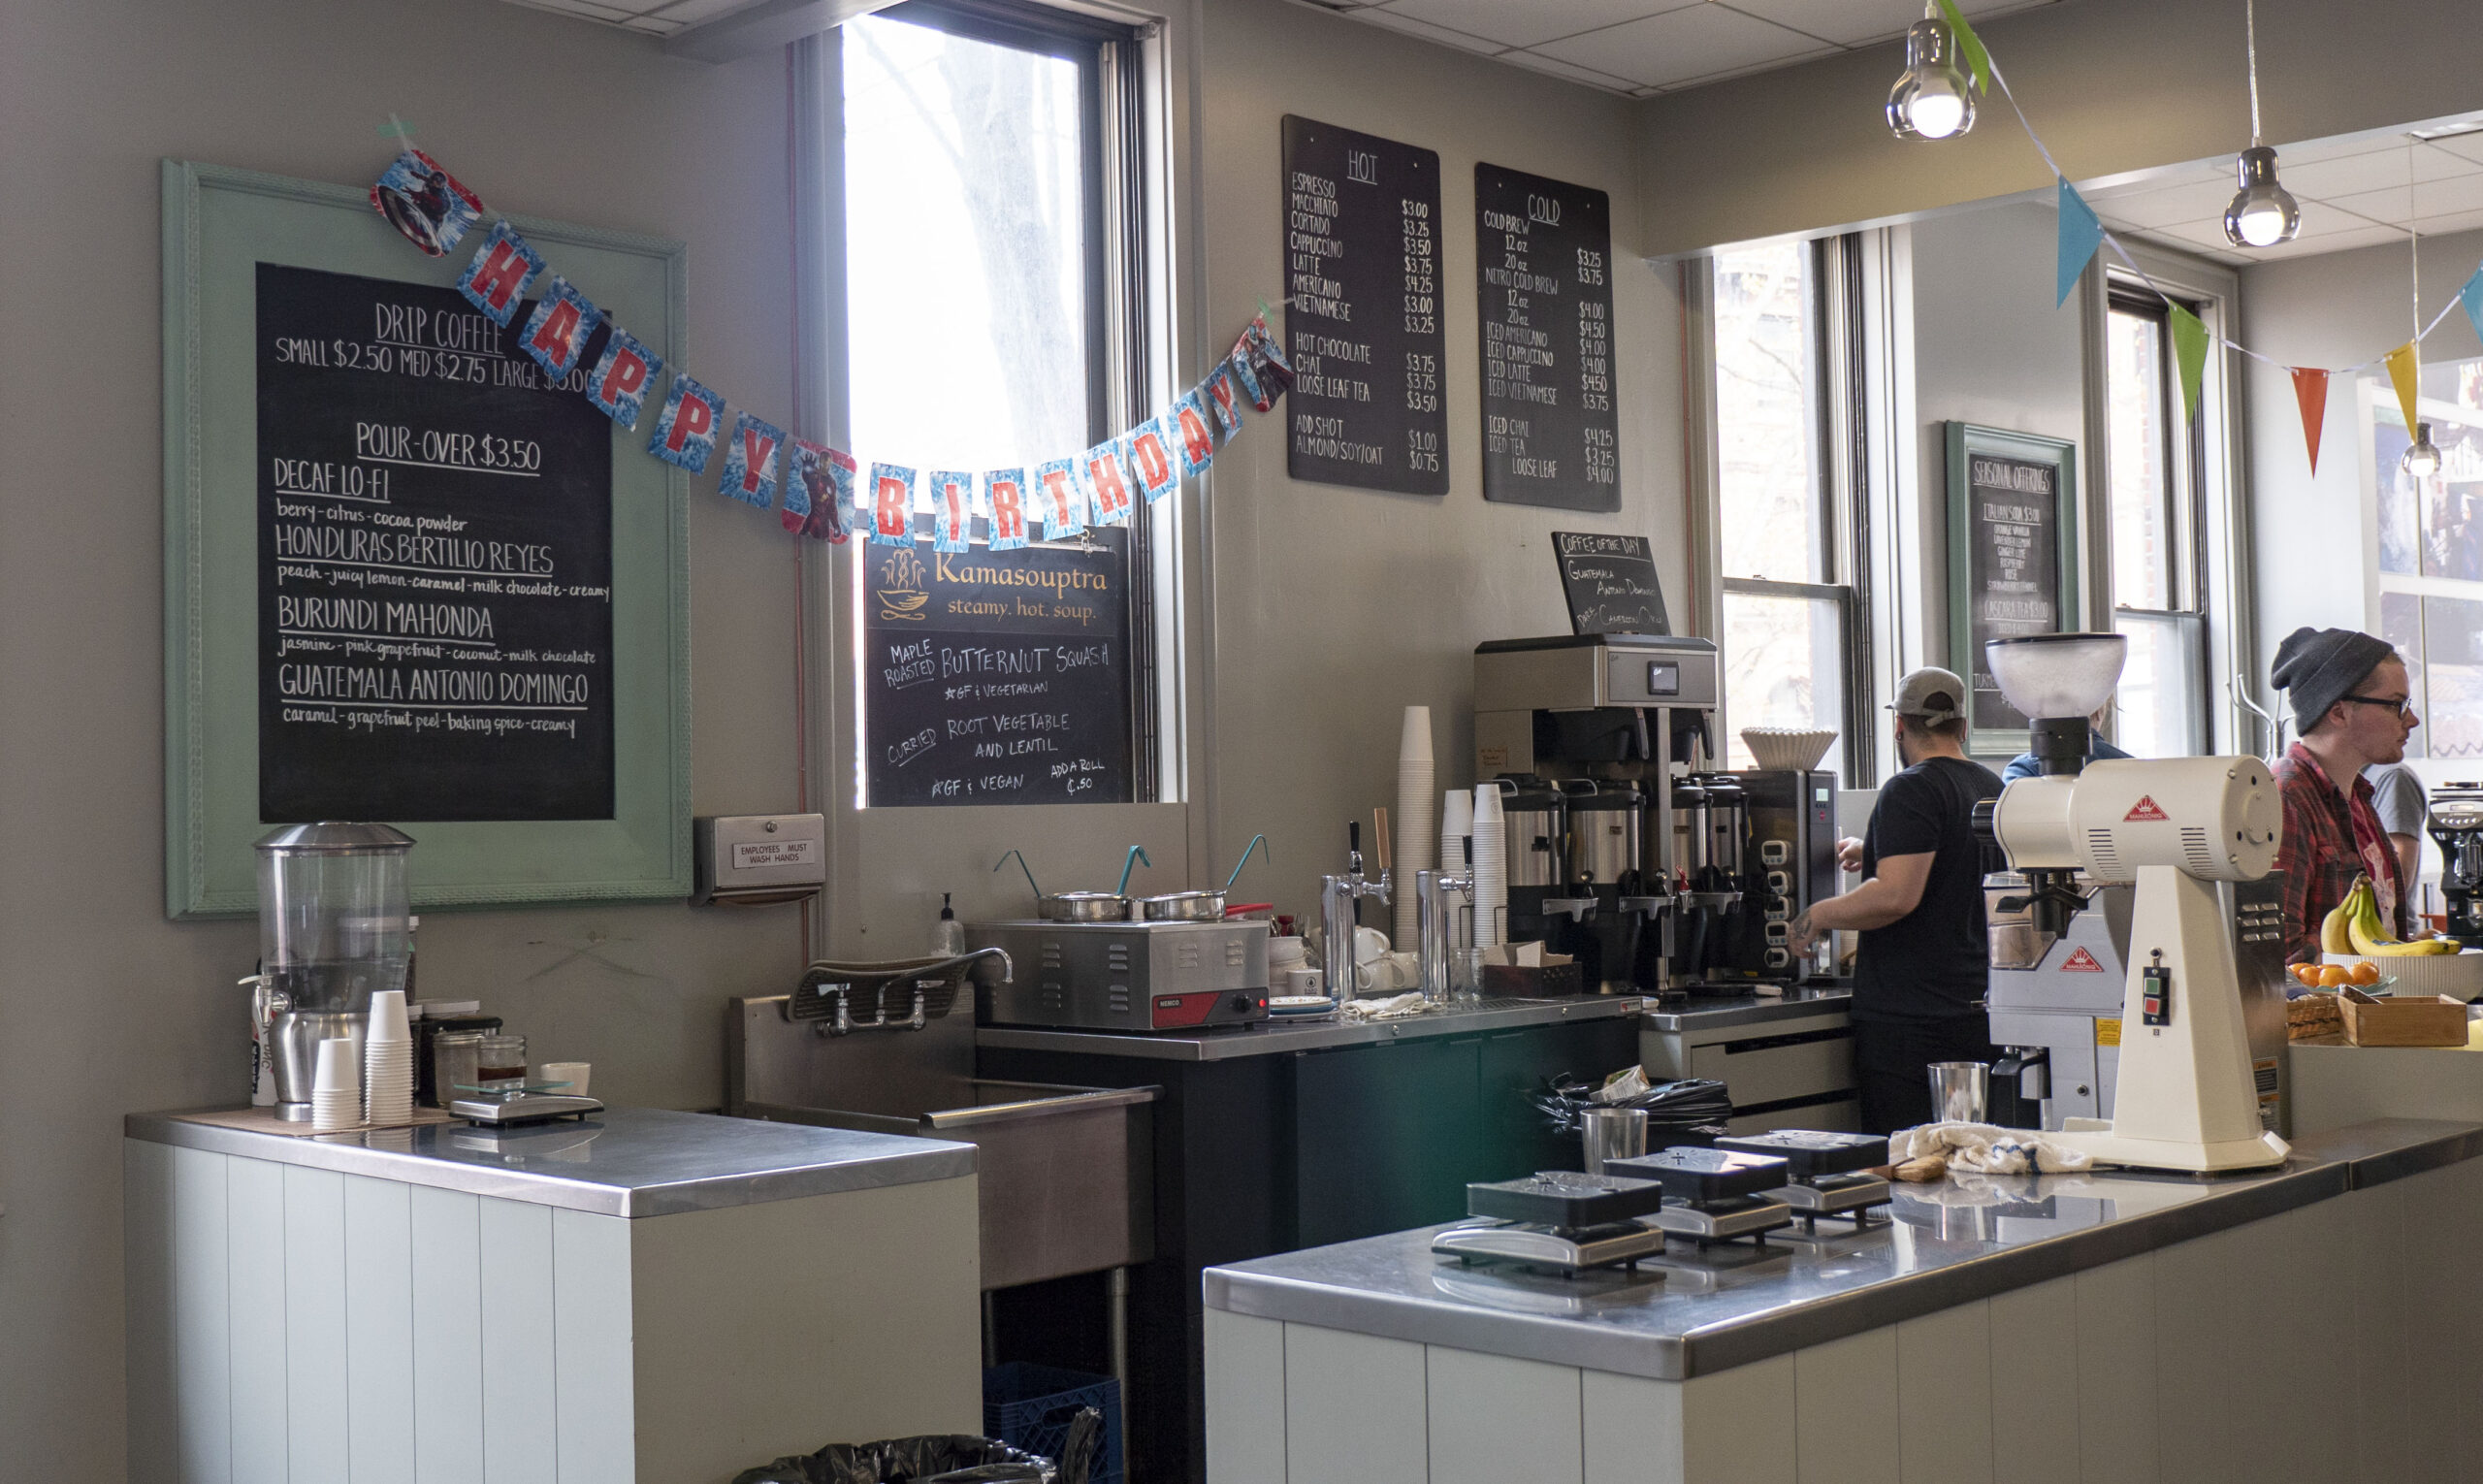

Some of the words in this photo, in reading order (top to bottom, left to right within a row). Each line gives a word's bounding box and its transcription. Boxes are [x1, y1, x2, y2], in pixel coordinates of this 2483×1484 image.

[1348, 149, 1378, 182] HOT
[1292, 172, 1336, 198] ESPRESSO
[1402, 199, 1428, 218] $3.00
[1528, 193, 1561, 223] COLD
[1292, 193, 1338, 217] MACCHIATO
[1403, 218, 1429, 238] $3.25
[1484, 210, 1504, 230] COLD
[1505, 215, 1531, 236] BREW
[1291, 210, 1330, 236] CORTADO
[1403, 236, 1431, 255] $3.50
[1505, 234, 1515, 250] 12
[1290, 231, 1343, 259] CAPPUCCINO
[1403, 254, 1432, 275] $3.75
[1293, 252, 1321, 275] LATTE
[1404, 274, 1434, 294] $4.25
[1485, 267, 1511, 288] NITRO
[1513, 271, 1533, 291] COLD
[1534, 275, 1559, 296] BREW
[1504, 253, 1517, 271] 20
[1578, 266, 1603, 286] $3.75
[1292, 273, 1341, 300] AMERICANO
[1403, 295, 1434, 314] $3.00
[1507, 289, 1517, 307] 12
[1578, 301, 1604, 320] $4.00
[375, 303, 428, 344] DRIP
[435, 309, 504, 355] COFFEE
[1293, 292, 1351, 322] VIETNAMESE
[1403, 315, 1435, 335] $3.25
[1507, 307, 1519, 324] 20
[1296, 332, 1315, 352] HOT
[1317, 337, 1371, 365] CHOCOLATE
[1406, 353, 1435, 373] $3.75
[1486, 321, 1503, 341] ICED
[1505, 325, 1548, 347] AMERICANO
[1580, 338, 1606, 356] $4.00
[1487, 339, 1504, 360] ICED
[1506, 344, 1554, 368] CAPPUCCINO
[275, 338, 329, 368] SMALL
[334, 341, 393, 372] $2.50
[400, 350, 431, 377] MED
[435, 352, 486, 384] $2.75
[493, 359, 539, 390] LARGE
[469, 239, 775, 494] HAPPY
[1296, 353, 1321, 375] CHAI
[1406, 372, 1435, 392] $3.75
[1488, 359, 1505, 378] ICED
[1507, 363, 1532, 382] LATTE
[1297, 374, 1325, 397] LOOSE
[1327, 377, 1350, 400] LEAF
[1352, 380, 1370, 403] TEA
[1406, 390, 1437, 413] $3.50
[1488, 378, 1505, 398] ICED
[1508, 381, 1558, 405] VIETNAMESE
[1296, 414, 1313, 435] ADD
[1315, 416, 1344, 438] SHOT
[1489, 415, 1507, 435] ICED
[1509, 418, 1530, 437] CHAI
[357, 421, 476, 468] POUR-OVER
[480, 435, 541, 471] $3.50
[877, 374, 1237, 541] BIRTHDAY
[1409, 450, 1440, 472] $0.75
[1489, 435, 1507, 454] ICED
[1509, 437, 1526, 456] TEA
[274, 458, 336, 493] DECAF
[341, 465, 389, 501] LO-FI
[1512, 458, 1536, 477] LOOSE
[1538, 460, 1558, 479] LEAF
[417, 514, 468, 536] powder
[275, 524, 394, 563] HONDURAS
[489, 541, 554, 573] REYES
[1560, 532, 1596, 555] COFFEE
[1621, 536, 1640, 556] DAY
[935, 552, 1108, 600] Kamasouptra
[278, 595, 379, 631] BURUNDI
[386, 601, 495, 639] MAHONDA
[948, 597, 1012, 623] steamy.
[1016, 596, 1049, 618] hot.
[1053, 602, 1097, 627] soup.
[541, 649, 597, 664] chocolate
[890, 638, 933, 664] MAPLE
[941, 647, 1049, 679] BUTTERNUT
[1055, 643, 1109, 673] SQUASH
[279, 663, 403, 700] GUATEMALA
[409, 668, 494, 701] ANTONIO
[500, 672, 589, 704] DOMINGO
[884, 659, 936, 688] ROASTED
[983, 680, 1049, 697] VEGETARIAN
[947, 716, 989, 740] ROOT
[992, 713, 1070, 733] VEGETABLE
[887, 727, 938, 764] CURRIED
[975, 742, 1004, 758] AND
[1009, 737, 1059, 757] LENTIL
[980, 774, 1025, 790] VEGAN
[1050, 764, 1069, 779] ADD
[1080, 758, 1106, 773] ROLL
[741, 845, 781, 855] EMPLOYEES
[788, 843, 807, 853] MUST
[749, 855, 771, 864] WASH
[775, 854, 799, 862] HANDS
[1159, 999, 1180, 1008] NEMCO
